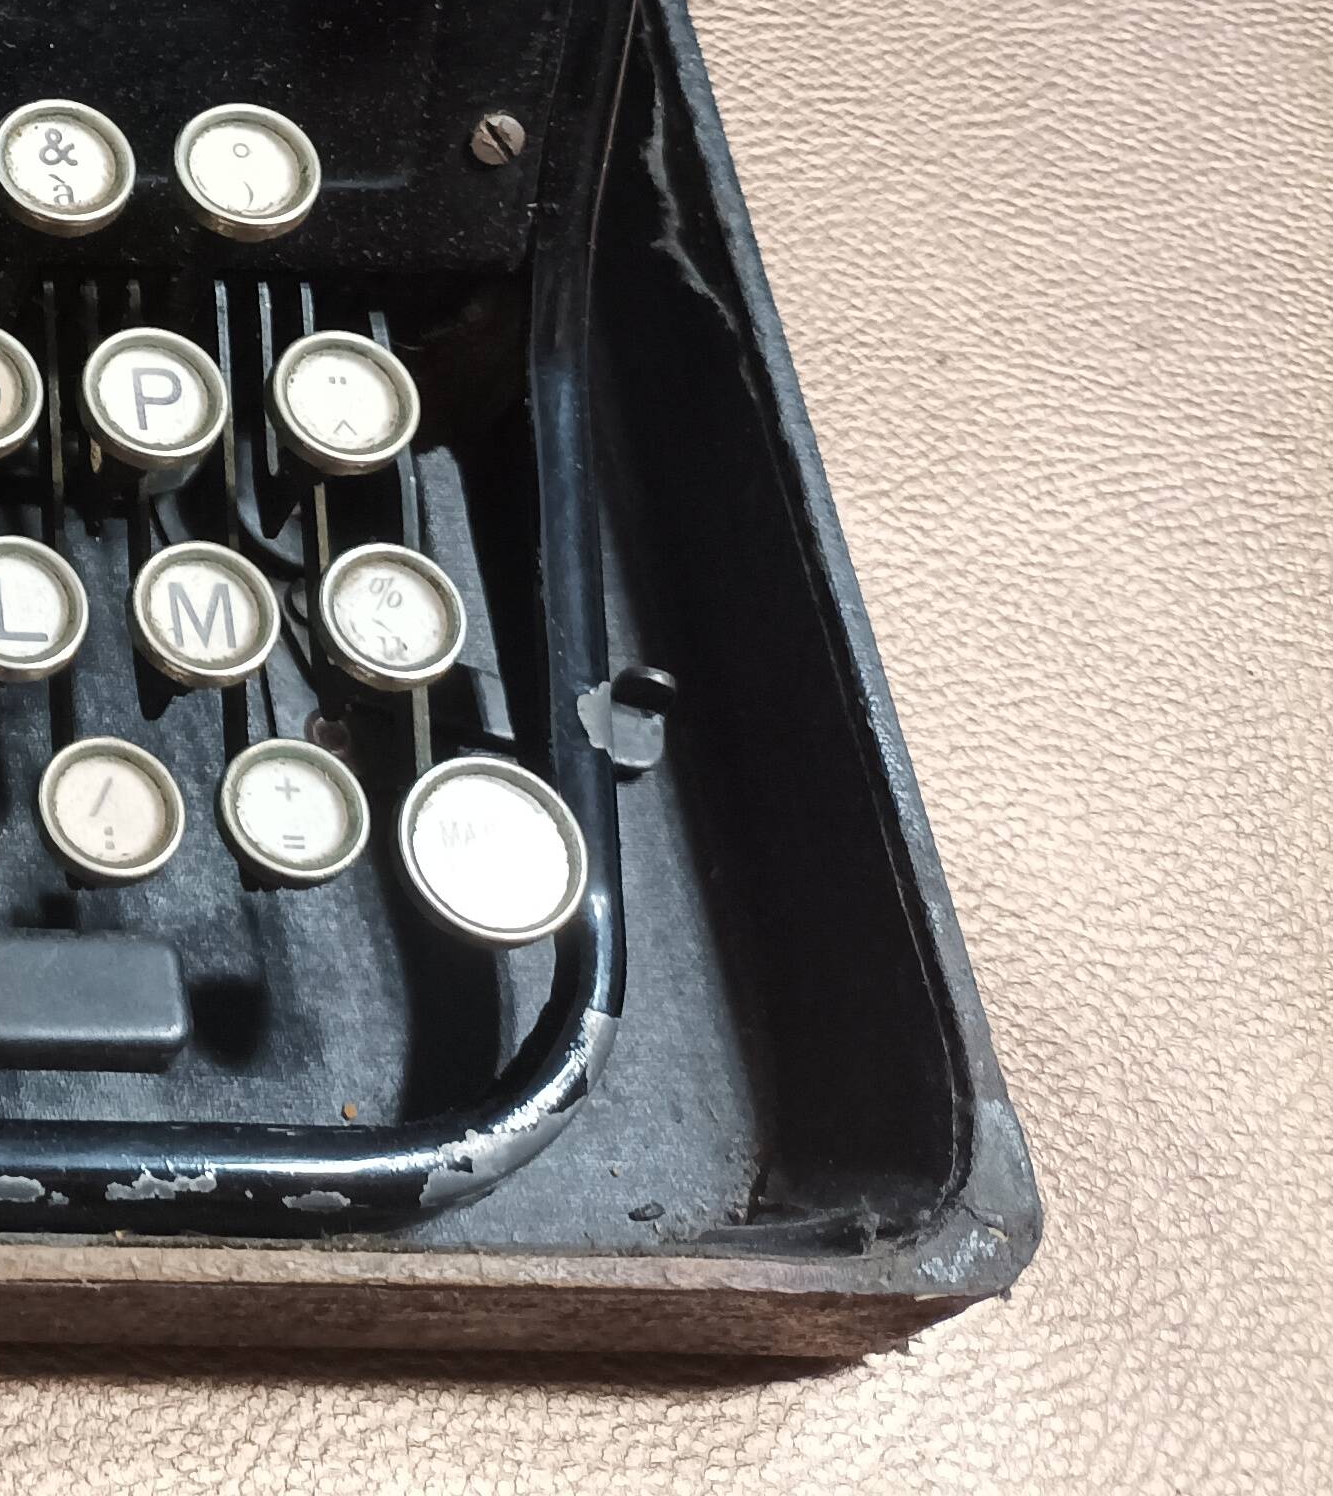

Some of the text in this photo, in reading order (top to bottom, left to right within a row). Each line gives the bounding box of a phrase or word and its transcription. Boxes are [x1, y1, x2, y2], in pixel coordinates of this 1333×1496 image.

[38, 127, 79, 168] &
[131, 367, 183, 430] P
[167, 581, 238, 649] M
